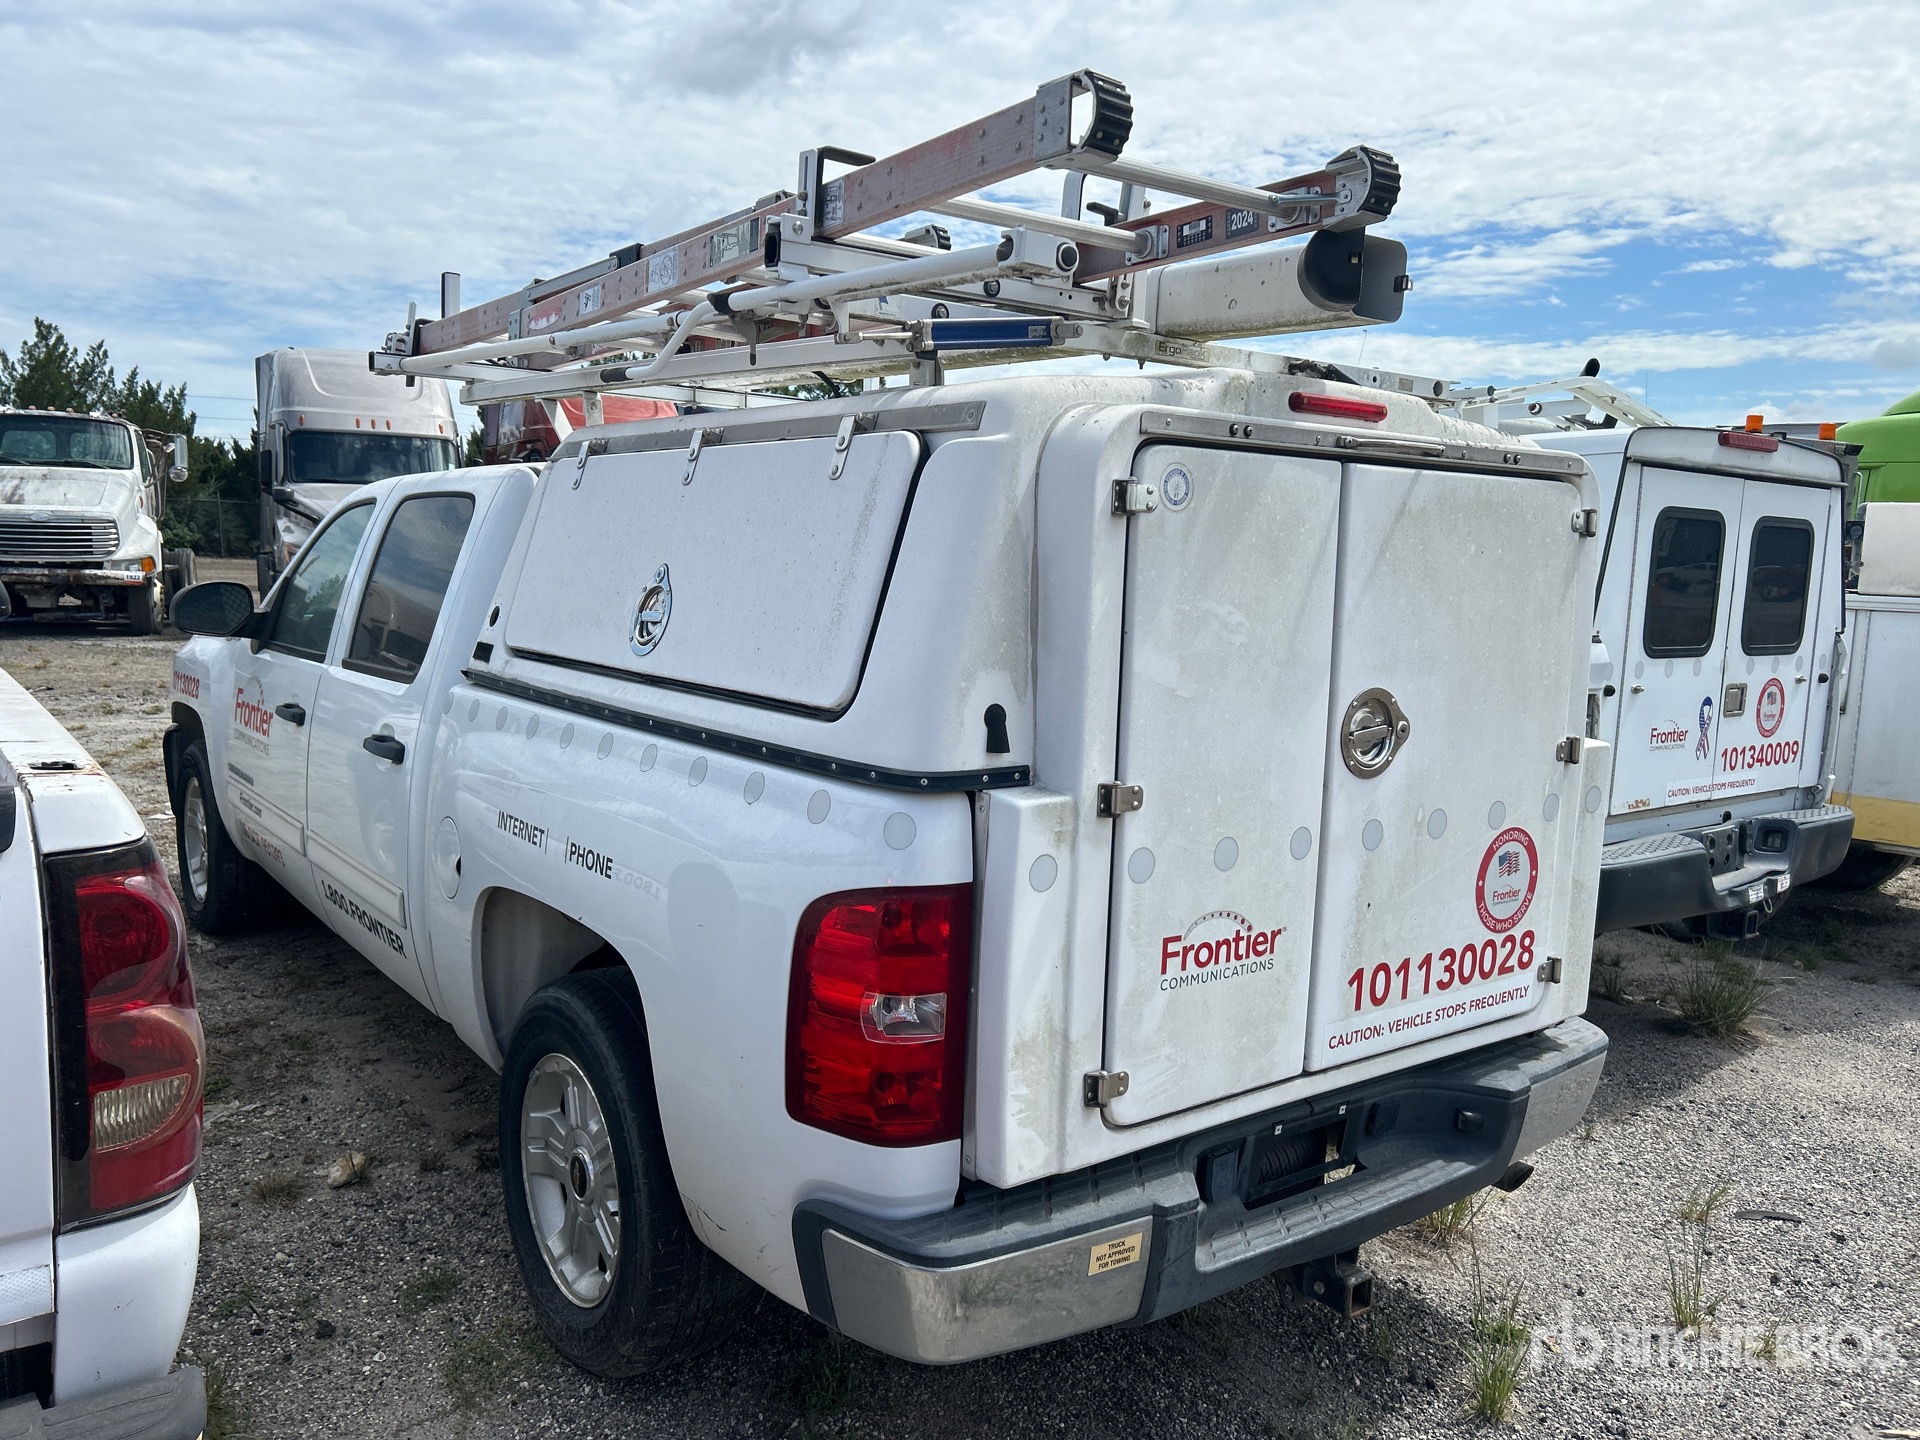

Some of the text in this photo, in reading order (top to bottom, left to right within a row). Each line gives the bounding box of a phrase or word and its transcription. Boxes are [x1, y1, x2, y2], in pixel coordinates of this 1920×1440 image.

[1231, 210, 1254, 231] 2024
[234, 687, 274, 738] Frontier
[1649, 726, 1689, 745] Frontier
[1721, 739, 1800, 772] 101340009
[1692, 784, 1711, 794] VEHICLE
[1711, 782, 1726, 791] STOPS
[1727, 778, 1757, 789] FREQUENTLY
[497, 810, 545, 848] INTERNET
[1492, 830, 1529, 851] HONORING
[569, 842, 614, 880] PHONE
[1478, 891, 1533, 931] THOSE WHO SERVE
[1492, 887, 1521, 902] Frontier
[1160, 925, 1282, 975] Frontier
[1160, 958, 1274, 991] COMMUNICATIONS
[1347, 929, 1536, 1012] 101130028
[1328, 985, 1530, 1050] CAUTION: VEHICLE STOPS FREQUENTLY
[1095, 1245, 1136, 1263] NOT APPROVED
[1108, 1240, 1126, 1251] TRUCK
[1098, 1255, 1131, 1270] FOR TOWING
